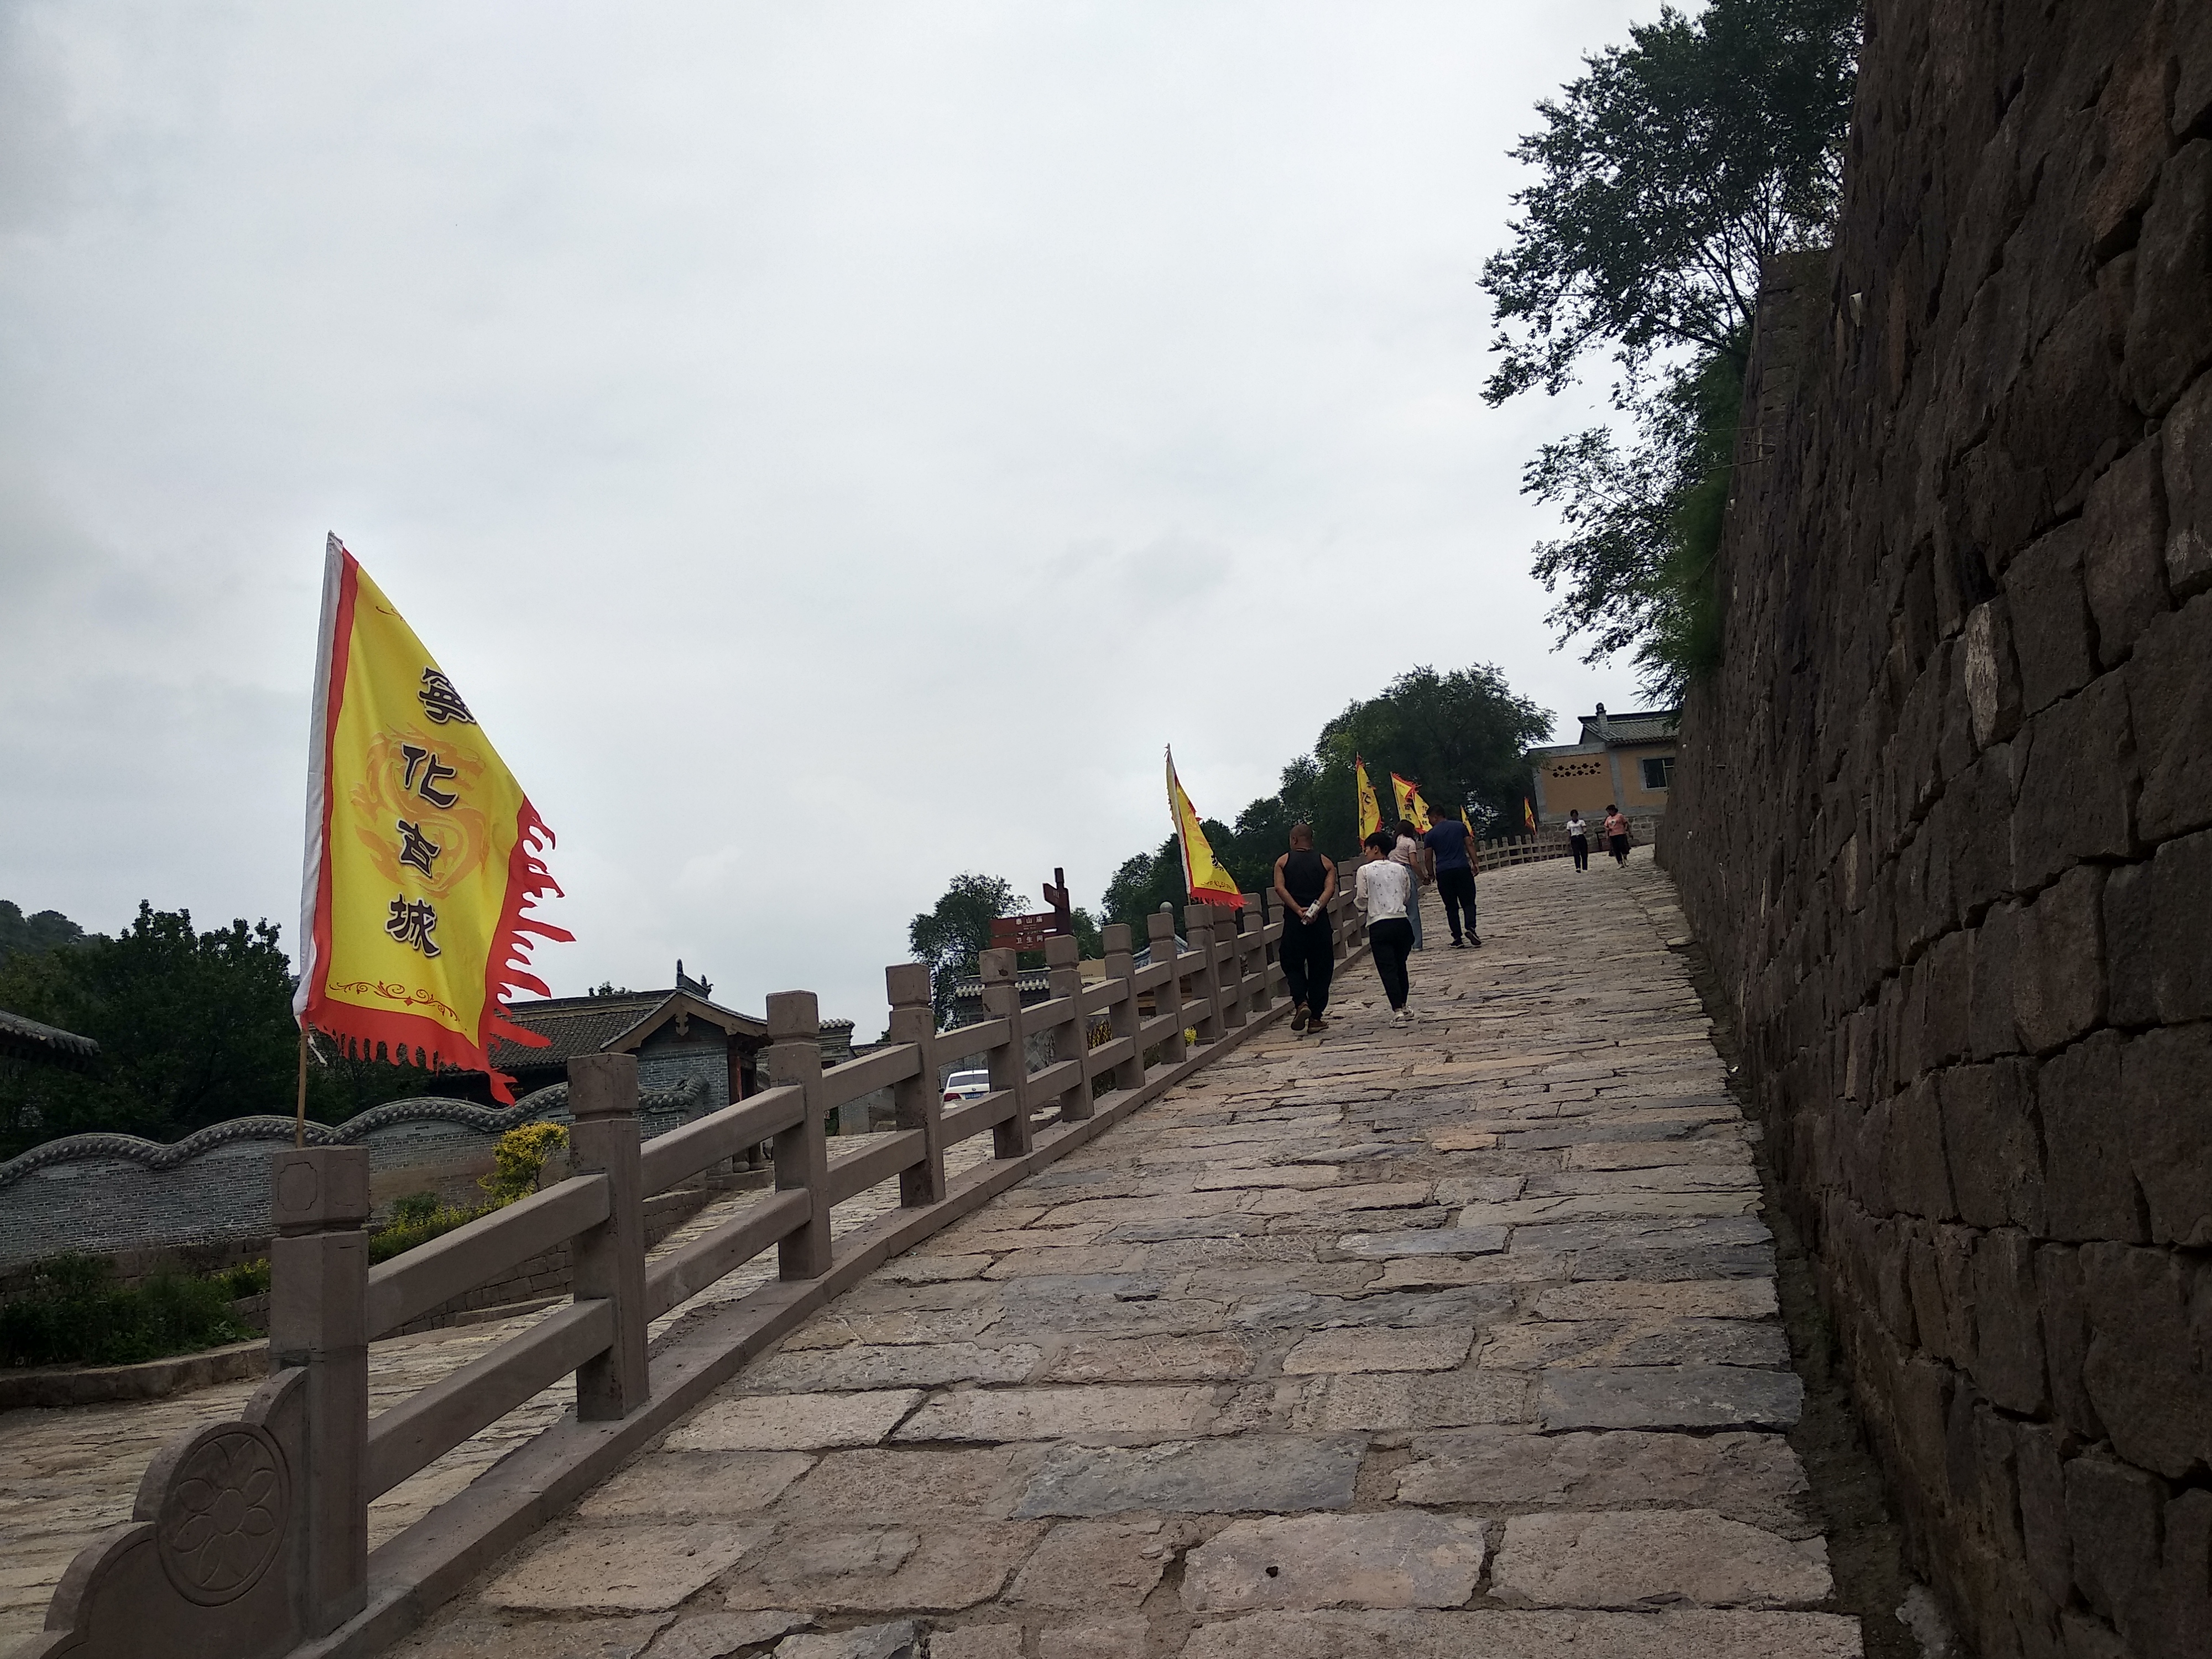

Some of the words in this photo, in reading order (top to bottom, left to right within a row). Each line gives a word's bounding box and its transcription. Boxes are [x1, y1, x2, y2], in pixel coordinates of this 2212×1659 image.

[1015, 916, 1043, 925] 泰山庙
[1016, 935, 1044, 945] 卫生间
